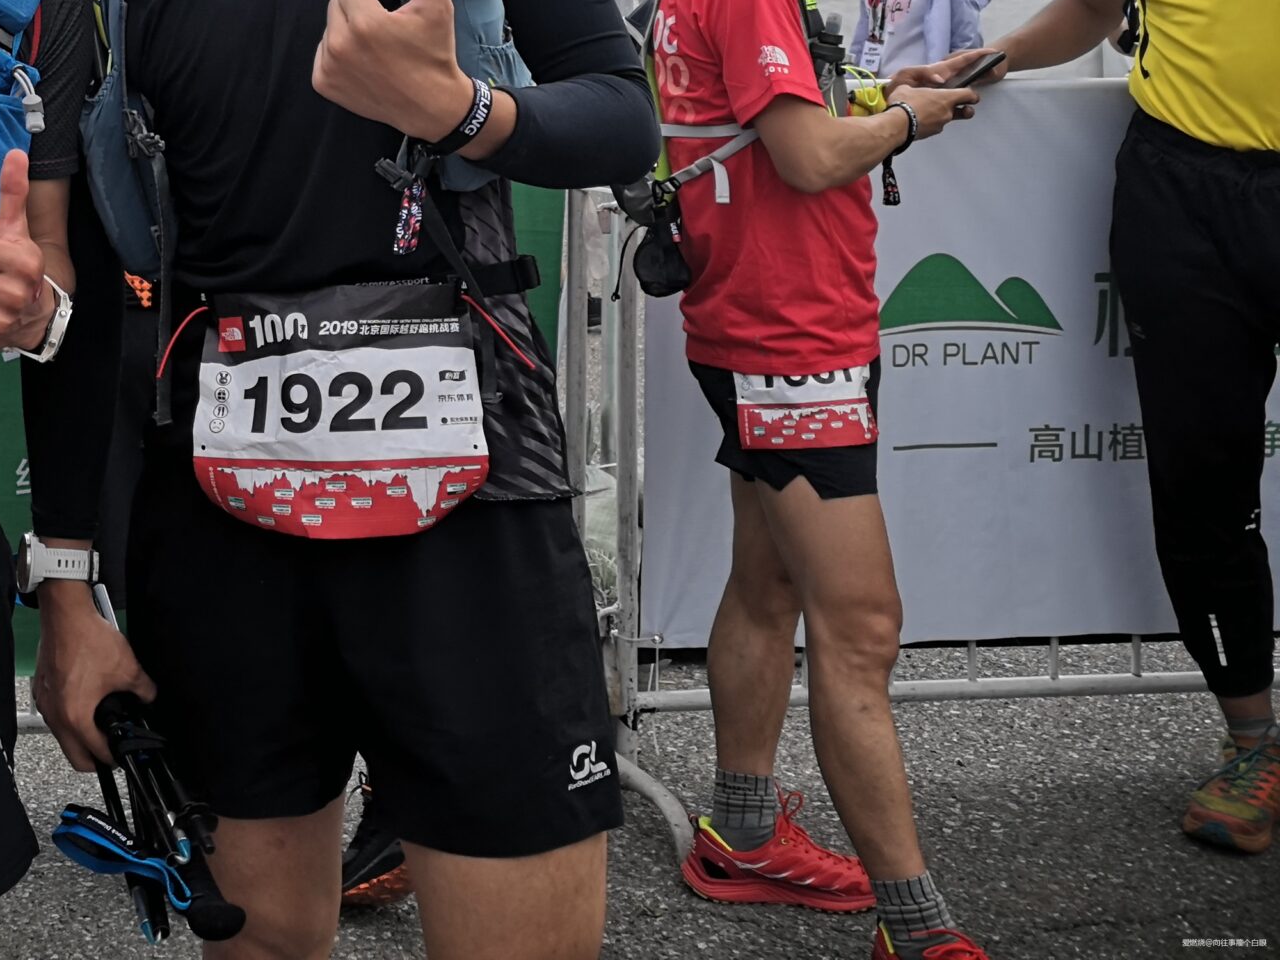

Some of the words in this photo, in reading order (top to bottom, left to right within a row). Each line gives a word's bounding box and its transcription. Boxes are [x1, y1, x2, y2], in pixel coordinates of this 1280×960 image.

[248, 311, 308, 348] 100
[319, 321, 358, 336] 2019
[359, 322, 460, 336] 北京国际越野跑挑战赛
[891, 342, 930, 368] DR
[942, 340, 1041, 367] PLANT
[243, 369, 429, 434] 1922
[1028, 423, 1146, 463] 高山植
